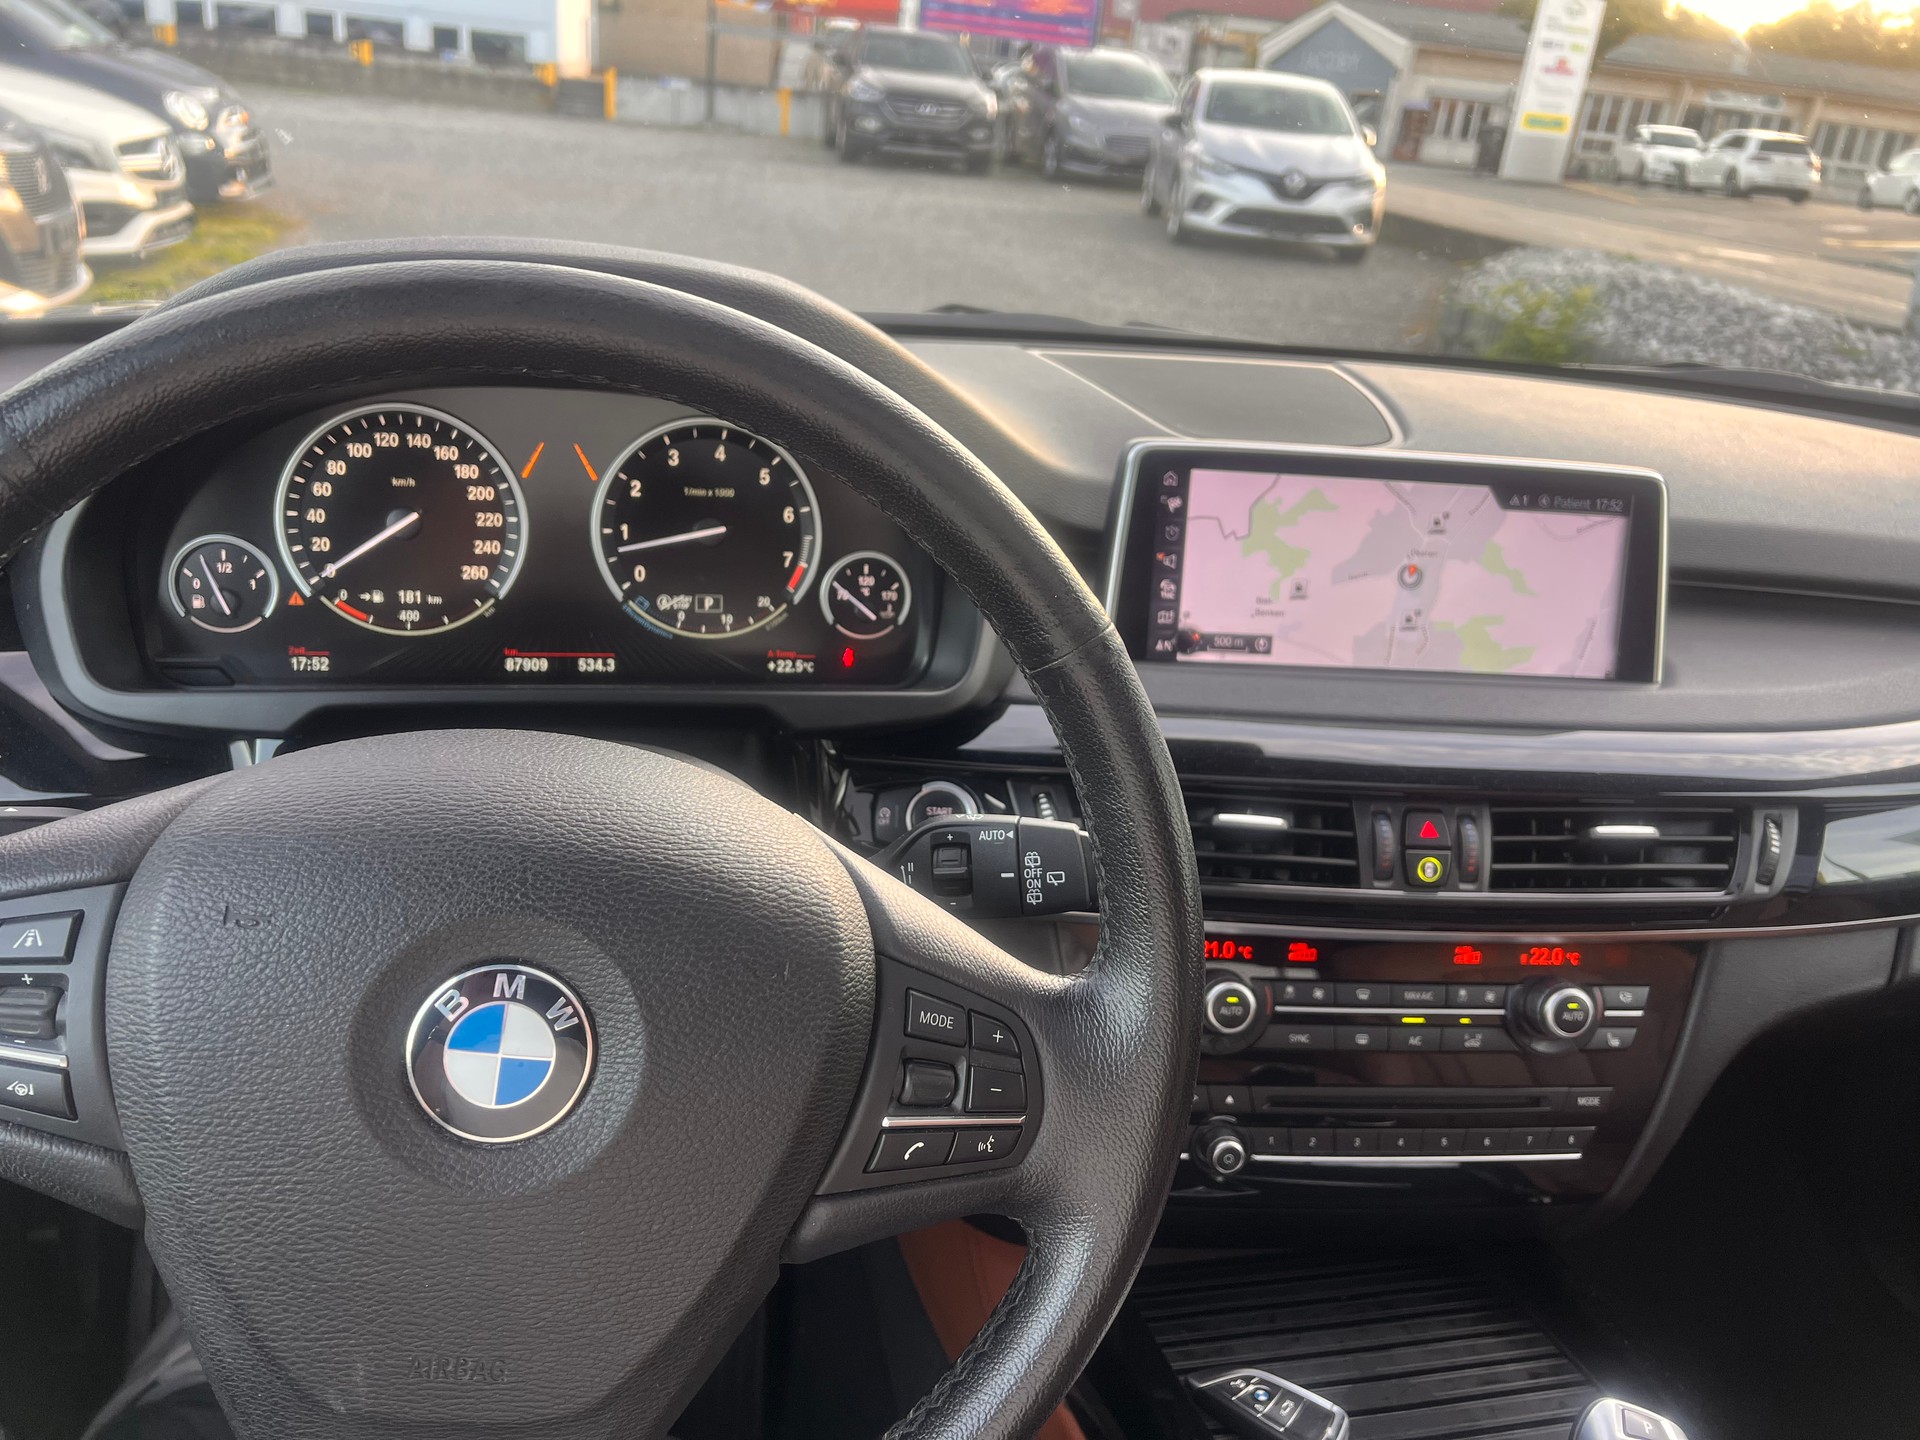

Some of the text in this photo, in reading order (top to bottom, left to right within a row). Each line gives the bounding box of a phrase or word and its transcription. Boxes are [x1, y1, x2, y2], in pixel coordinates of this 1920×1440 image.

[374, 432, 399, 448] 120
[406, 433, 431, 449] 140
[346, 442, 372, 459] 100
[434, 445, 459, 461] 160
[667, 449, 680, 467] 3
[714, 444, 727, 462] 4
[327, 459, 346, 476] 80
[454, 463, 479, 480] 180
[392, 477, 416, 488] km/h
[759, 468, 771, 485] 5
[312, 482, 332, 498] 60
[467, 486, 495, 502] 200
[629, 479, 642, 497] 2
[306, 508, 326, 524] 40
[476, 513, 503, 529] 220
[783, 506, 796, 524] 6
[620, 523, 629, 541] 1
[311, 537, 331, 553] 20
[474, 541, 501, 556] 240
[783, 551, 793, 568] 7
[217, 562, 233, 574] 1/2
[462, 565, 488, 581] 260
[634, 565, 646, 583] 0
[192, 578, 201, 589] 0
[249, 579, 256, 590] 1
[398, 590, 442, 605] 181 km
[704, 597, 714, 611] P
[757, 596, 770, 607] 20
[720, 614, 733, 624] 10
[1214, 635, 1244, 647] 500 m
[291, 656, 330, 671] 17:52
[926, 806, 953, 816] START
[979, 829, 1005, 841] AUTO
[1024, 868, 1043, 878] OFF
[1027, 879, 1042, 889] ON
[1530, 948, 1563, 965] 22.0
[435, 973, 579, 1031] BMW
[1220, 1006, 1243, 1016] AUTO
[1562, 1010, 1583, 1021] AUTO
[919, 1010, 954, 1030] MODE
[1288, 1033, 1310, 1043] SYNC
[1577, 1097, 1600, 1106] MODE
[1309, 1137, 1317, 1147] 2
[1354, 1138, 1361, 1147] 3
[1527, 1135, 1533, 1145] 7
[409, 1358, 507, 1382] AIRBAG
[1643, 1421, 1652, 1434] P
